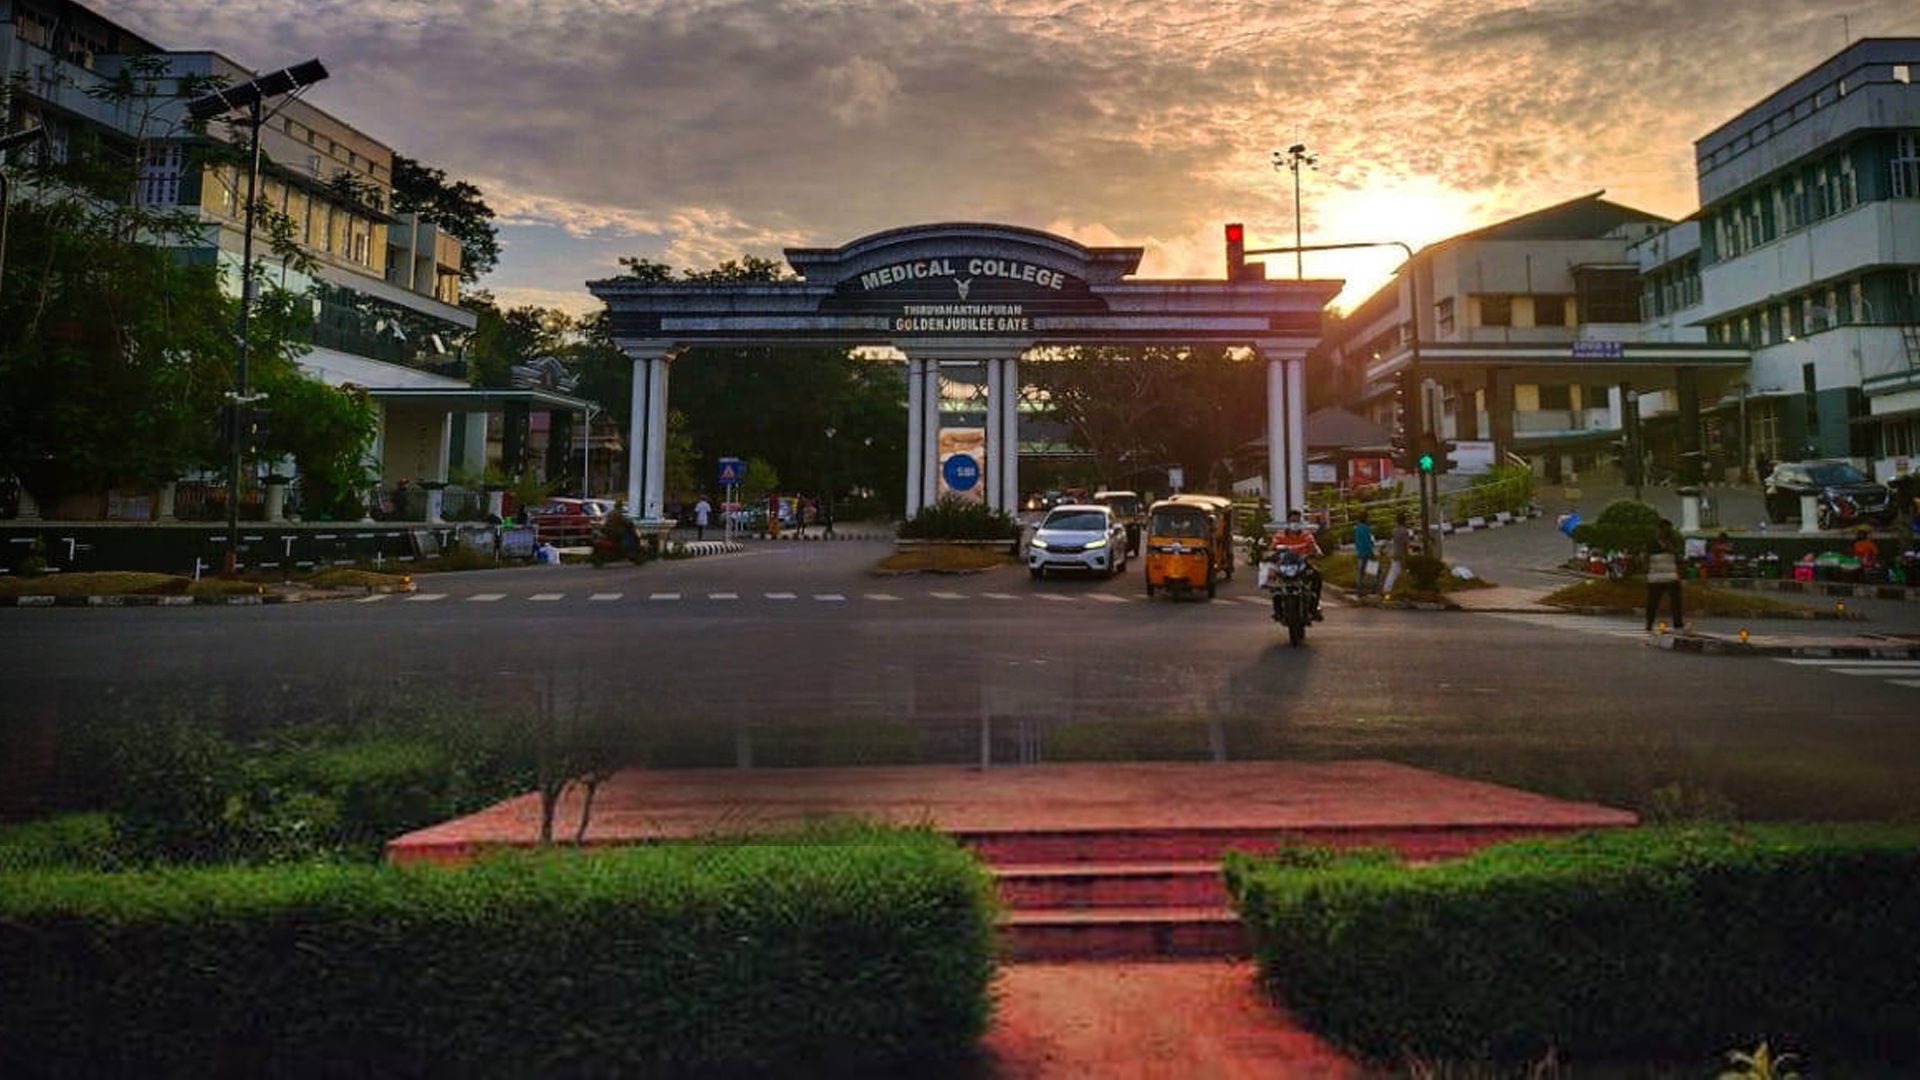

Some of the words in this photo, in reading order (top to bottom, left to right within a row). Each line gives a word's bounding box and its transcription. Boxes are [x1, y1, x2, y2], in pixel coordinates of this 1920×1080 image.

[860, 259, 955, 291] MEDICAL
[969, 258, 1066, 291] COLLEGE
[896, 317, 944, 331] GOLDEN
[998, 317, 1029, 331] GATE
